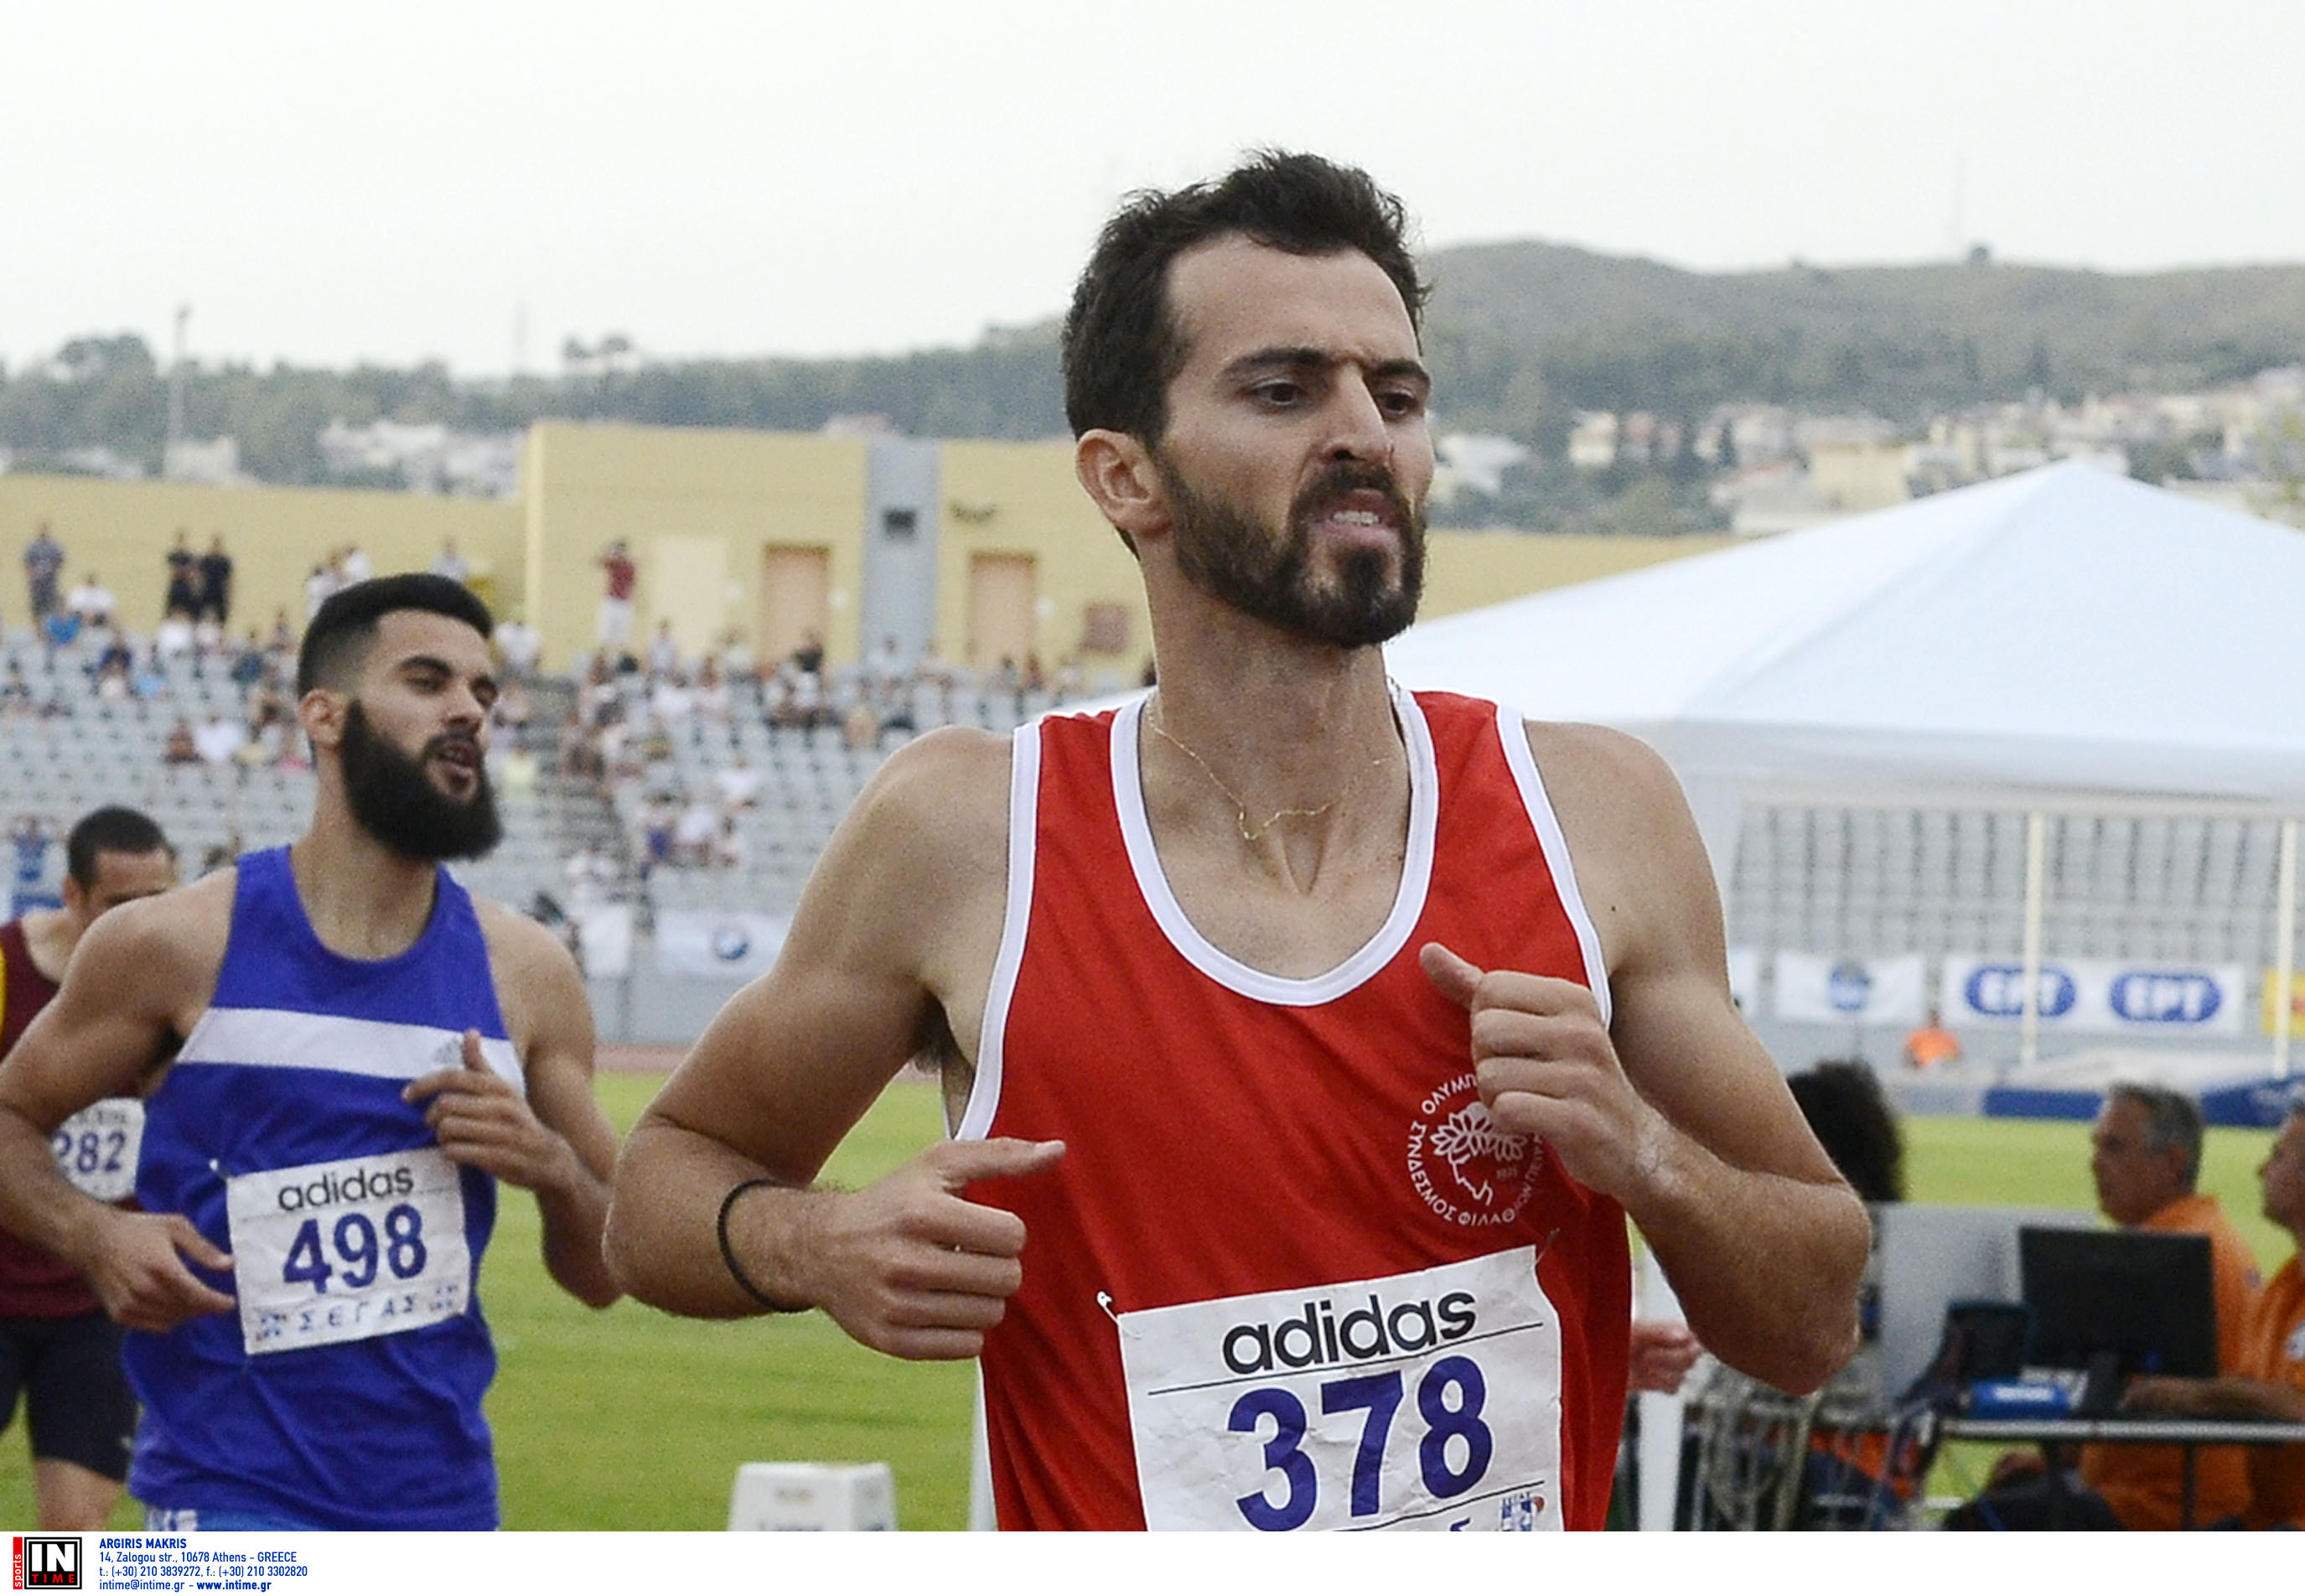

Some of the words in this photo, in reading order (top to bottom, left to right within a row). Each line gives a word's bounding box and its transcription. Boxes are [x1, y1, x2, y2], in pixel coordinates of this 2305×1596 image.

[278, 1166, 414, 1212] adidas
[1407, 1121, 1457, 1221] ΣΥΝΔΕΣΜΟΣ
[283, 1204, 427, 1293] 498
[1223, 1292, 1476, 1374] adidas
[1227, 1355, 1494, 1531] 378
